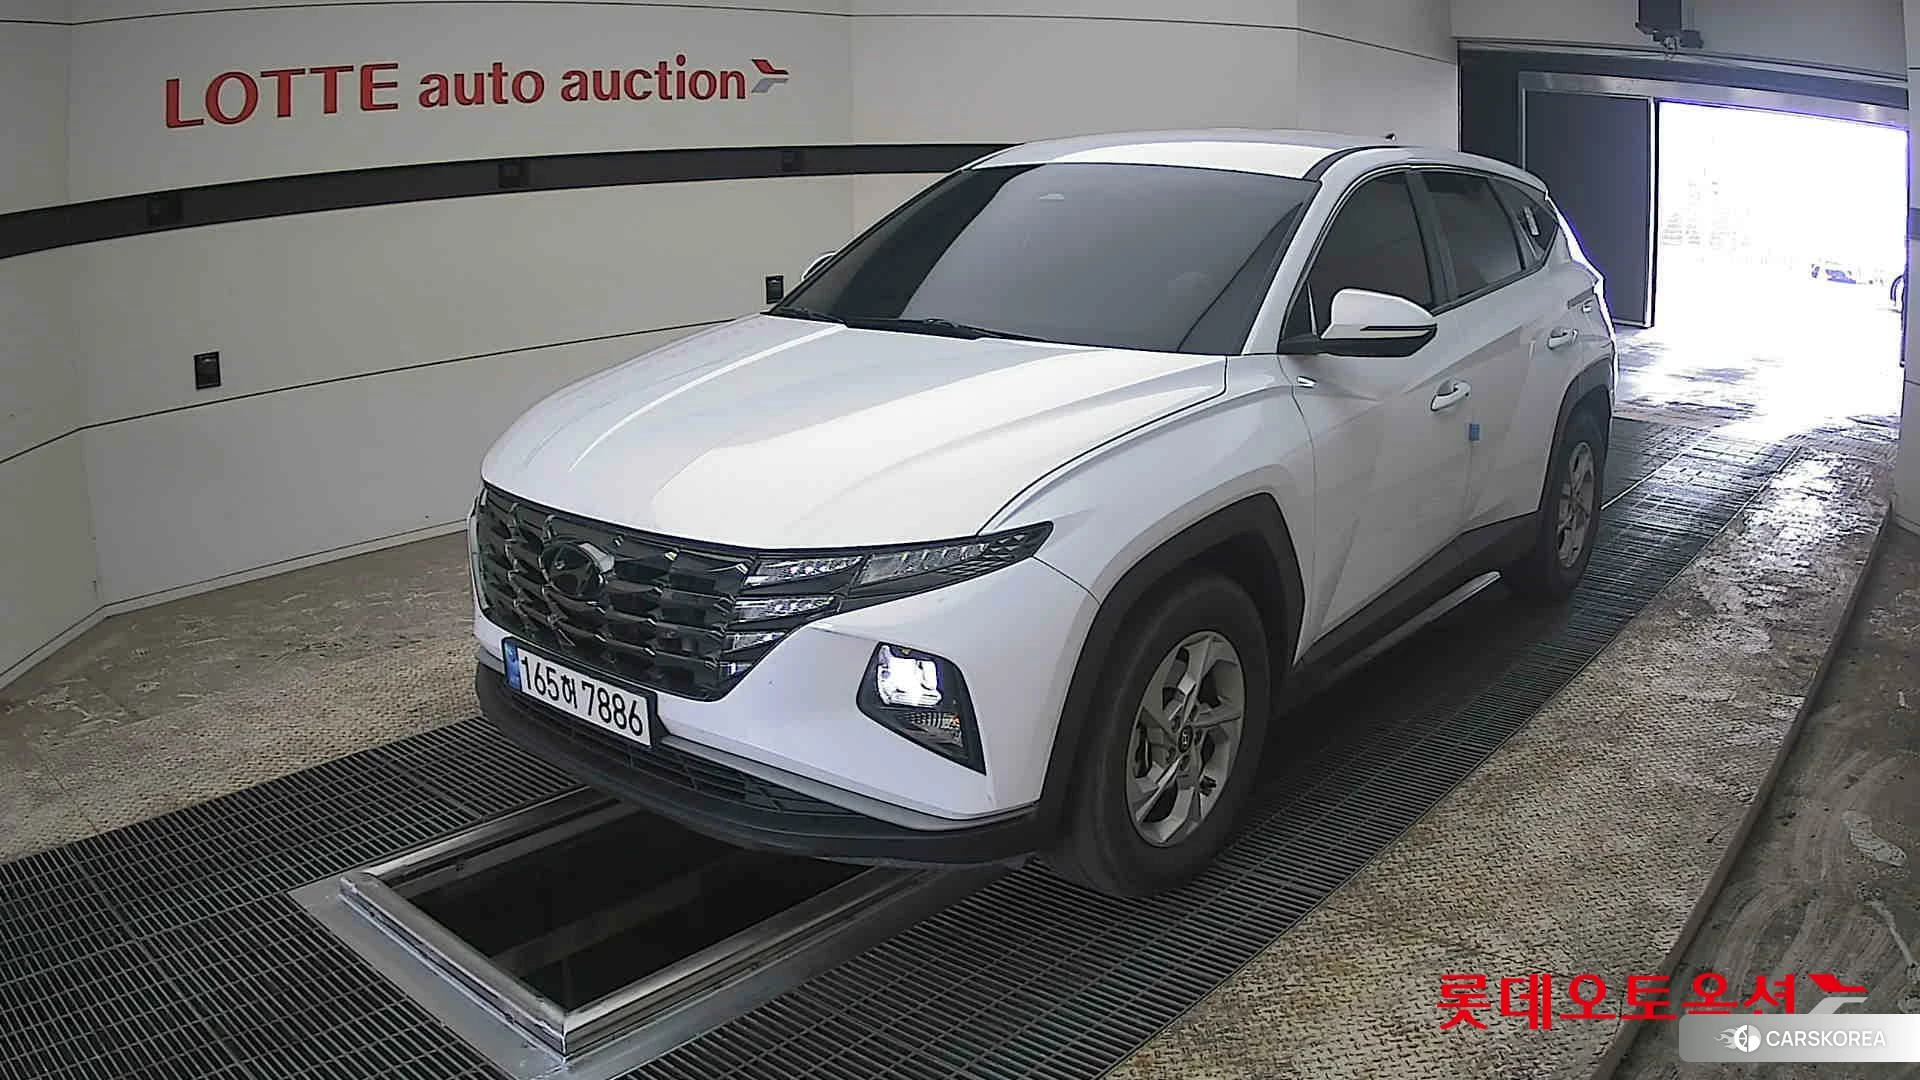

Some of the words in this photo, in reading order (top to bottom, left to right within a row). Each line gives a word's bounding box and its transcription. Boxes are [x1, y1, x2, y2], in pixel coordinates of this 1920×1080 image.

[165, 62, 399, 128] LOTTE
[418, 62, 546, 108] auto
[561, 54, 747, 102] auction
[581, 681, 643, 736] 7886
